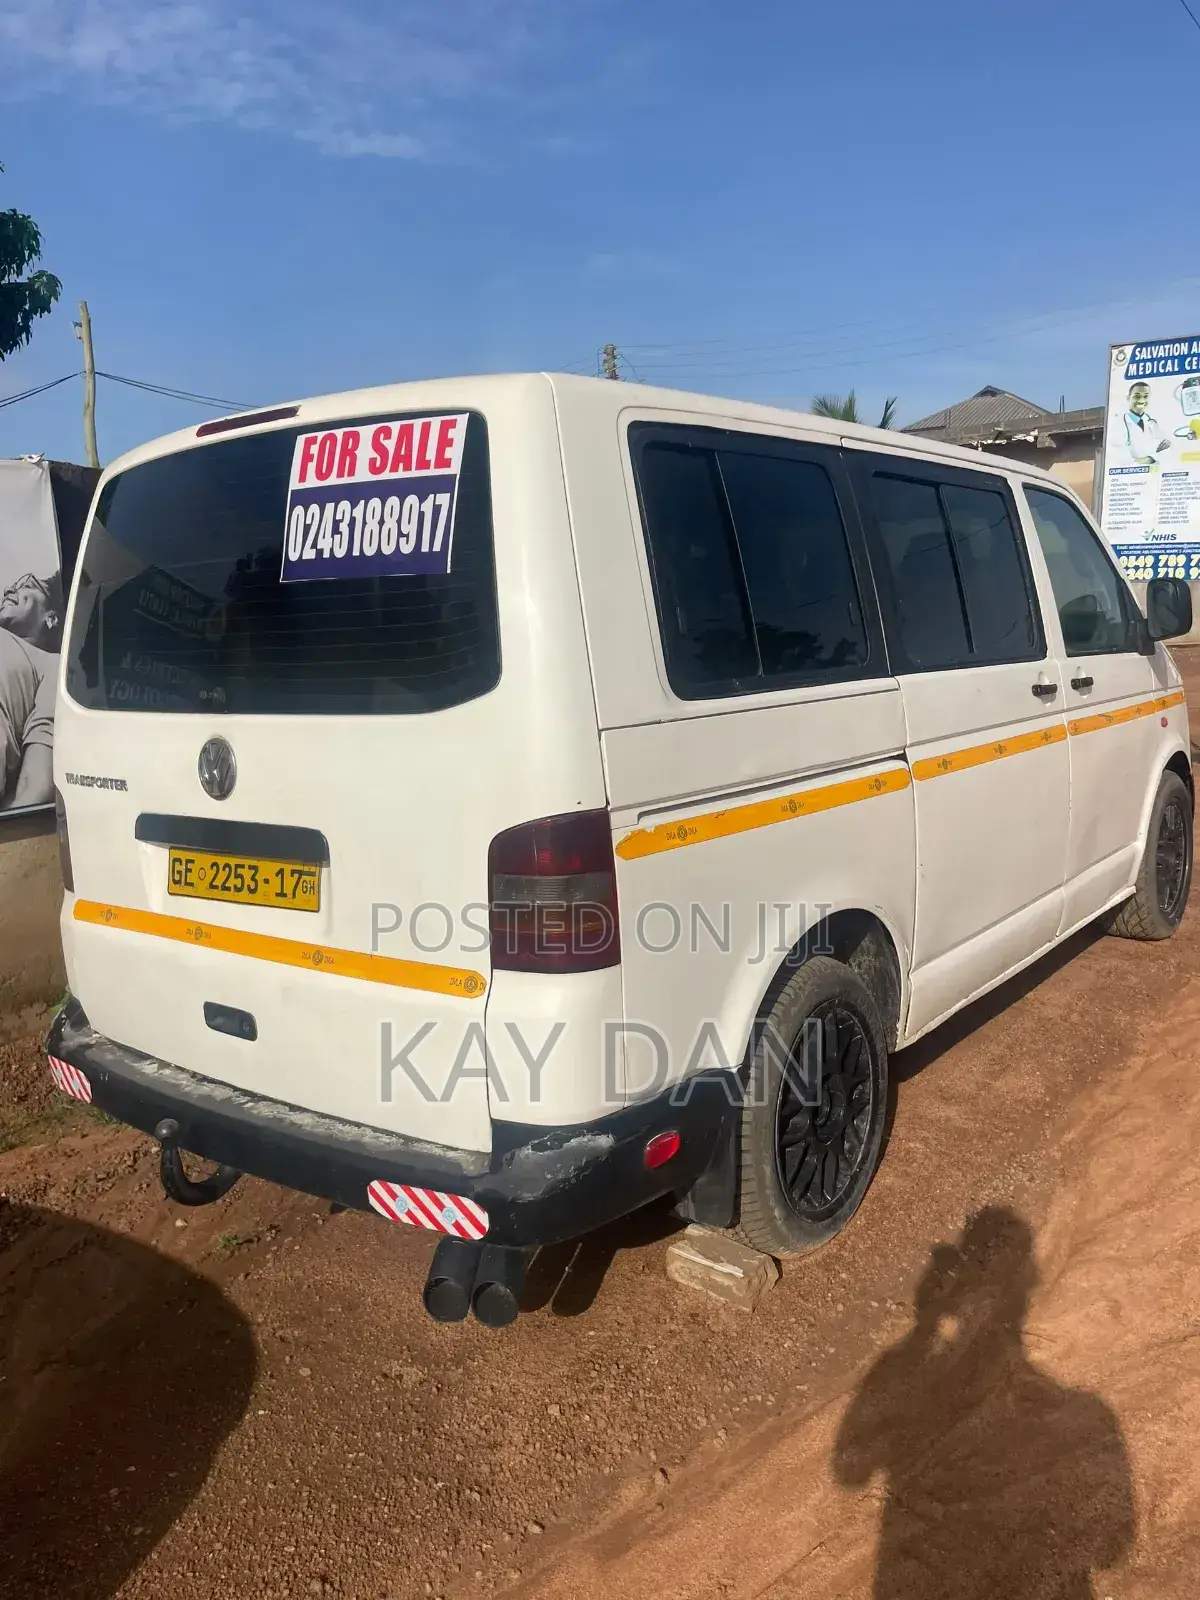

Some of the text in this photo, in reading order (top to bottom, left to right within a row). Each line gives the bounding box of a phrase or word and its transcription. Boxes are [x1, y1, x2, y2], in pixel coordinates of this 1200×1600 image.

[1135, 341, 1200, 360] SALVATION A
[1128, 357, 1200, 376] MEDICAL CE
[298, 419, 458, 483] FOR SALE
[288, 493, 450, 562] 0243188917
[1119, 554, 1200, 568] 0549 789 7
[1123, 567, 1200, 580] 240 710 9
[171, 858, 195, 887] GE
[302, 880, 315, 895] GH
